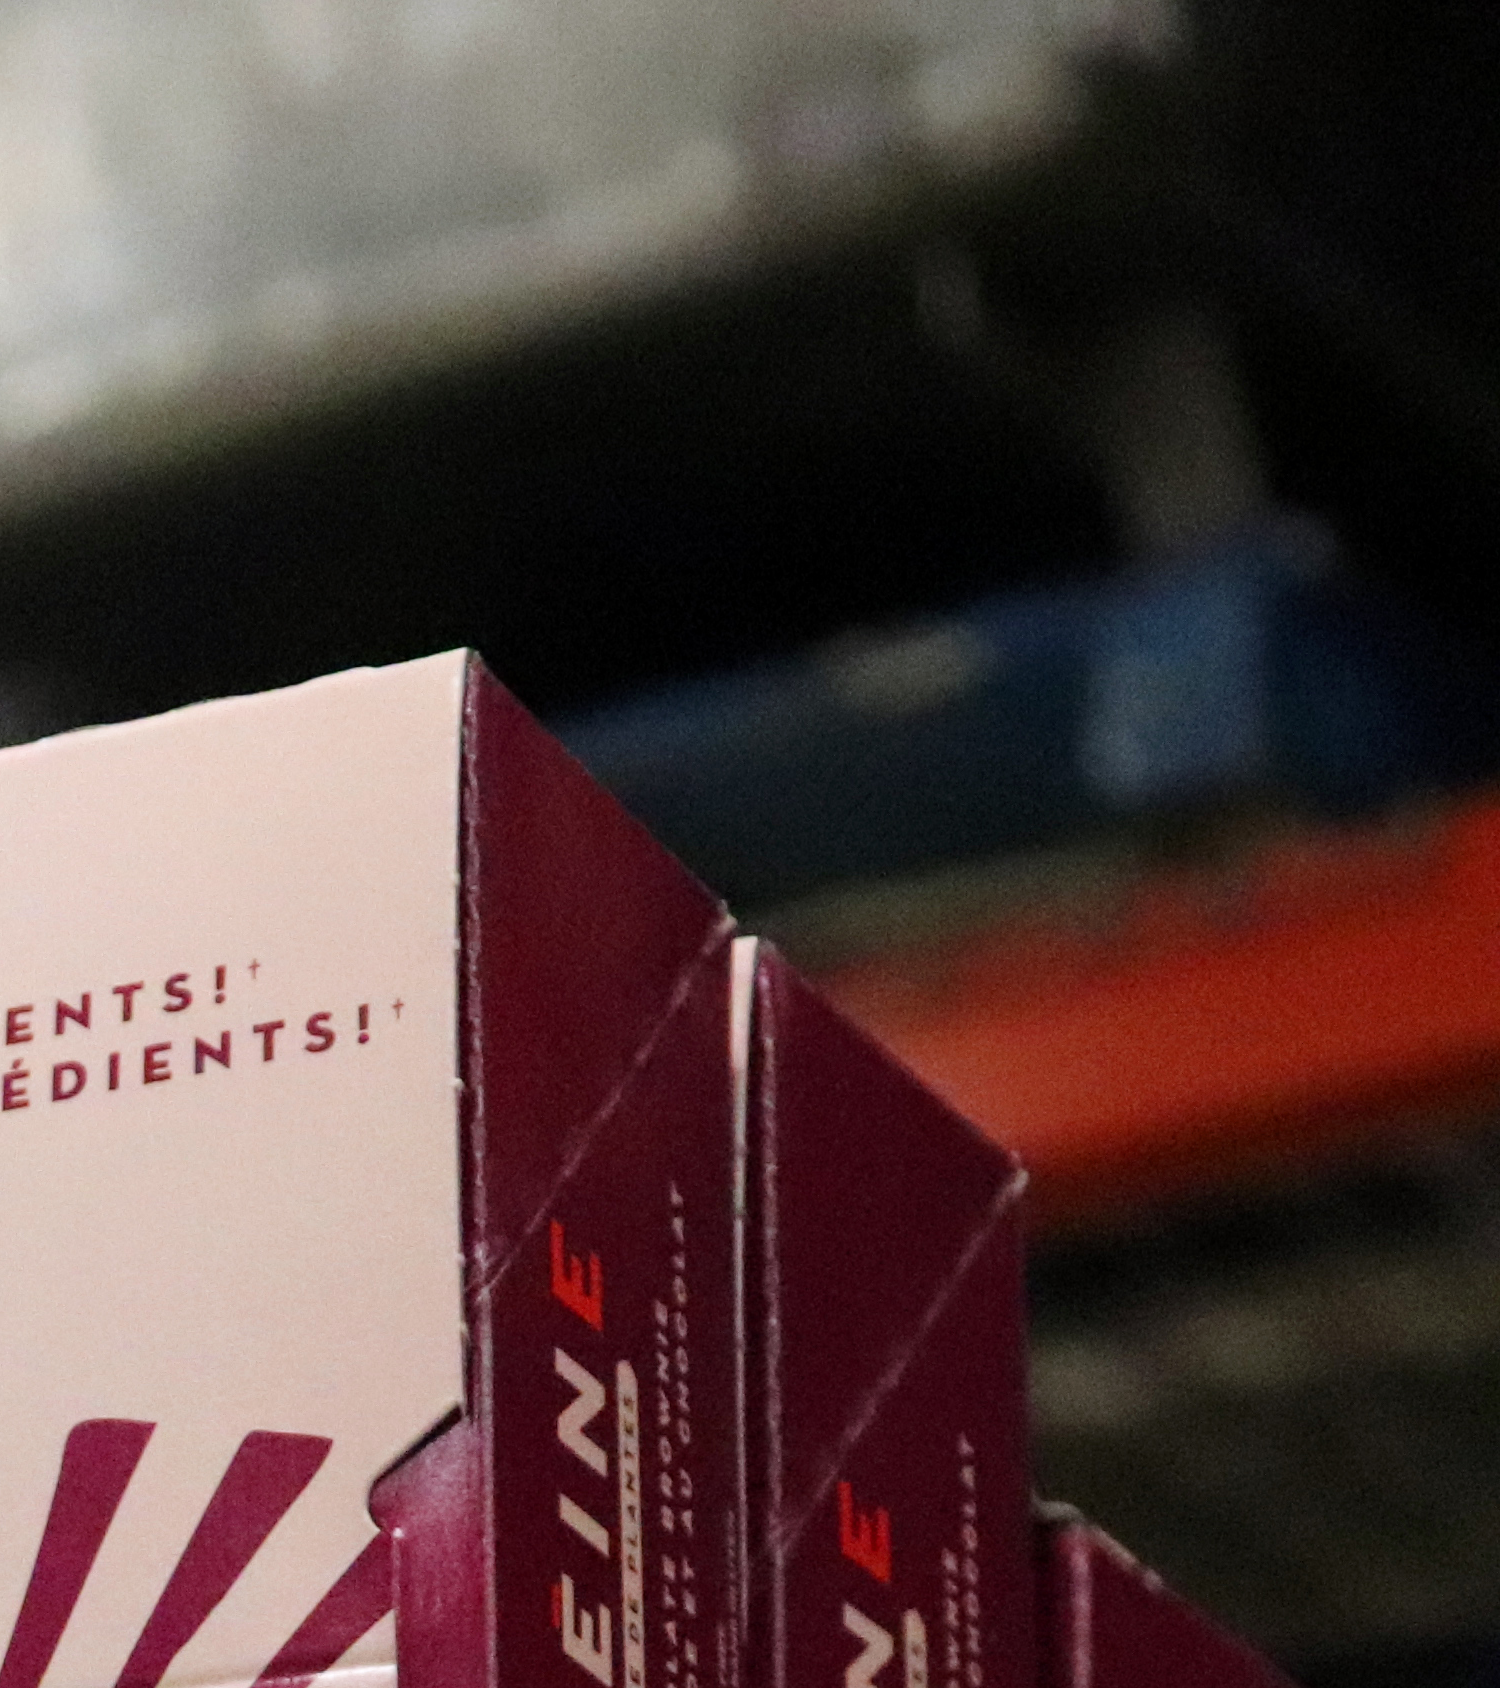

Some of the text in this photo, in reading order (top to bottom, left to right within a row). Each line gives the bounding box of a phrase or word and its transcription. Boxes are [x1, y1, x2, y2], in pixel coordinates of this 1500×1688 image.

[666, 1179, 693, 1447] CHOCOLAT
[652, 1296, 676, 1534] BROWNIE
[621, 1392, 642, 1577] PLANTES
[677, 1477, 696, 1537] AU
[624, 1605, 643, 1646] DE
[679, 1565, 699, 1619] ET
